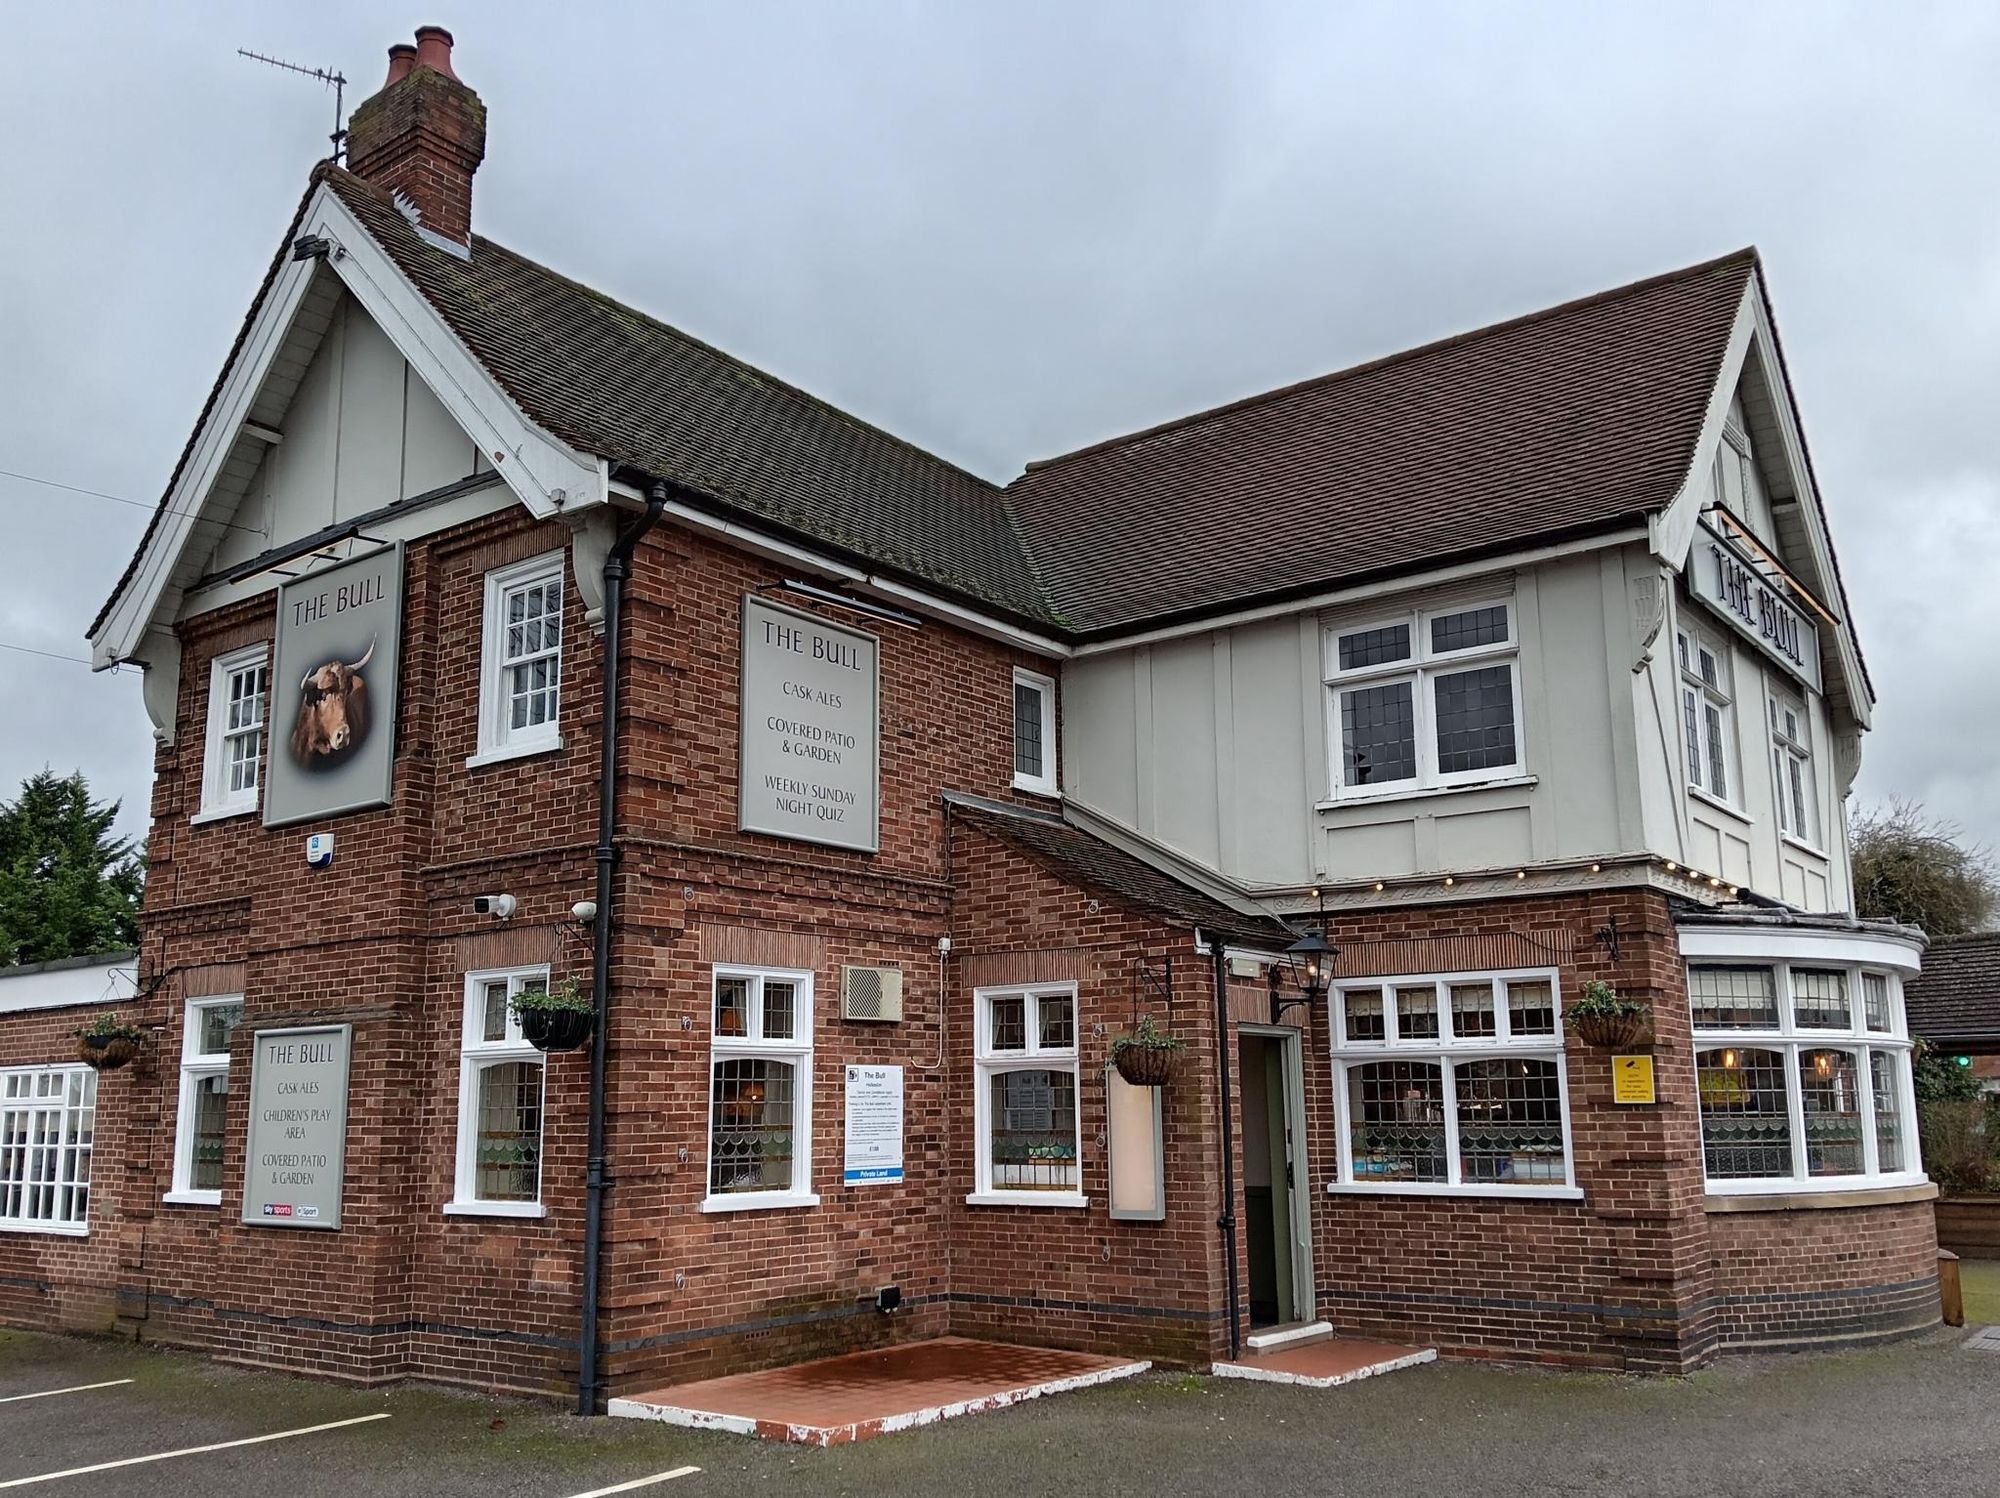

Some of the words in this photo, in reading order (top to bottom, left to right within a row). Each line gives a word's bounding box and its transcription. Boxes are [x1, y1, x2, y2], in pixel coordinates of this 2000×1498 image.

[293, 593, 328, 626] THE
[336, 575, 385, 613] BULL
[1711, 544, 1757, 625] THE
[1758, 586, 1804, 667] BULL
[762, 620, 804, 654] THE
[812, 635, 862, 671] BULL
[782, 681, 813, 702] CASK
[815, 690, 842, 709] ALES
[767, 716, 822, 741] COVERED
[824, 729, 856, 750] PATIO
[782, 739, 791, 753] &
[794, 742, 842, 765] GARDEN
[765, 775, 809, 796] WEEKLY
[811, 784, 857, 805] SUNDAY
[776, 797, 813, 816] NIGHT
[816, 804, 845, 823] QUIZ
[269, 1045, 295, 1065] THE
[300, 1043, 335, 1063] BULL
[864, 1071, 875, 1079] The
[277, 1082, 298, 1095] CASK
[300, 1081, 320, 1094] ALES
[263, 1108, 309, 1122] CHILDREN'S
[310, 1109, 332, 1121] PLAY
[283, 1126, 306, 1139] AREA
[262, 1153, 299, 1167] COVERED
[301, 1154, 327, 1168] PATIO
[271, 1171, 278, 1184] &
[280, 1172, 315, 1185] GARDEN
[860, 1170, 876, 1178] Private
[274, 1206, 291, 1215] sports
